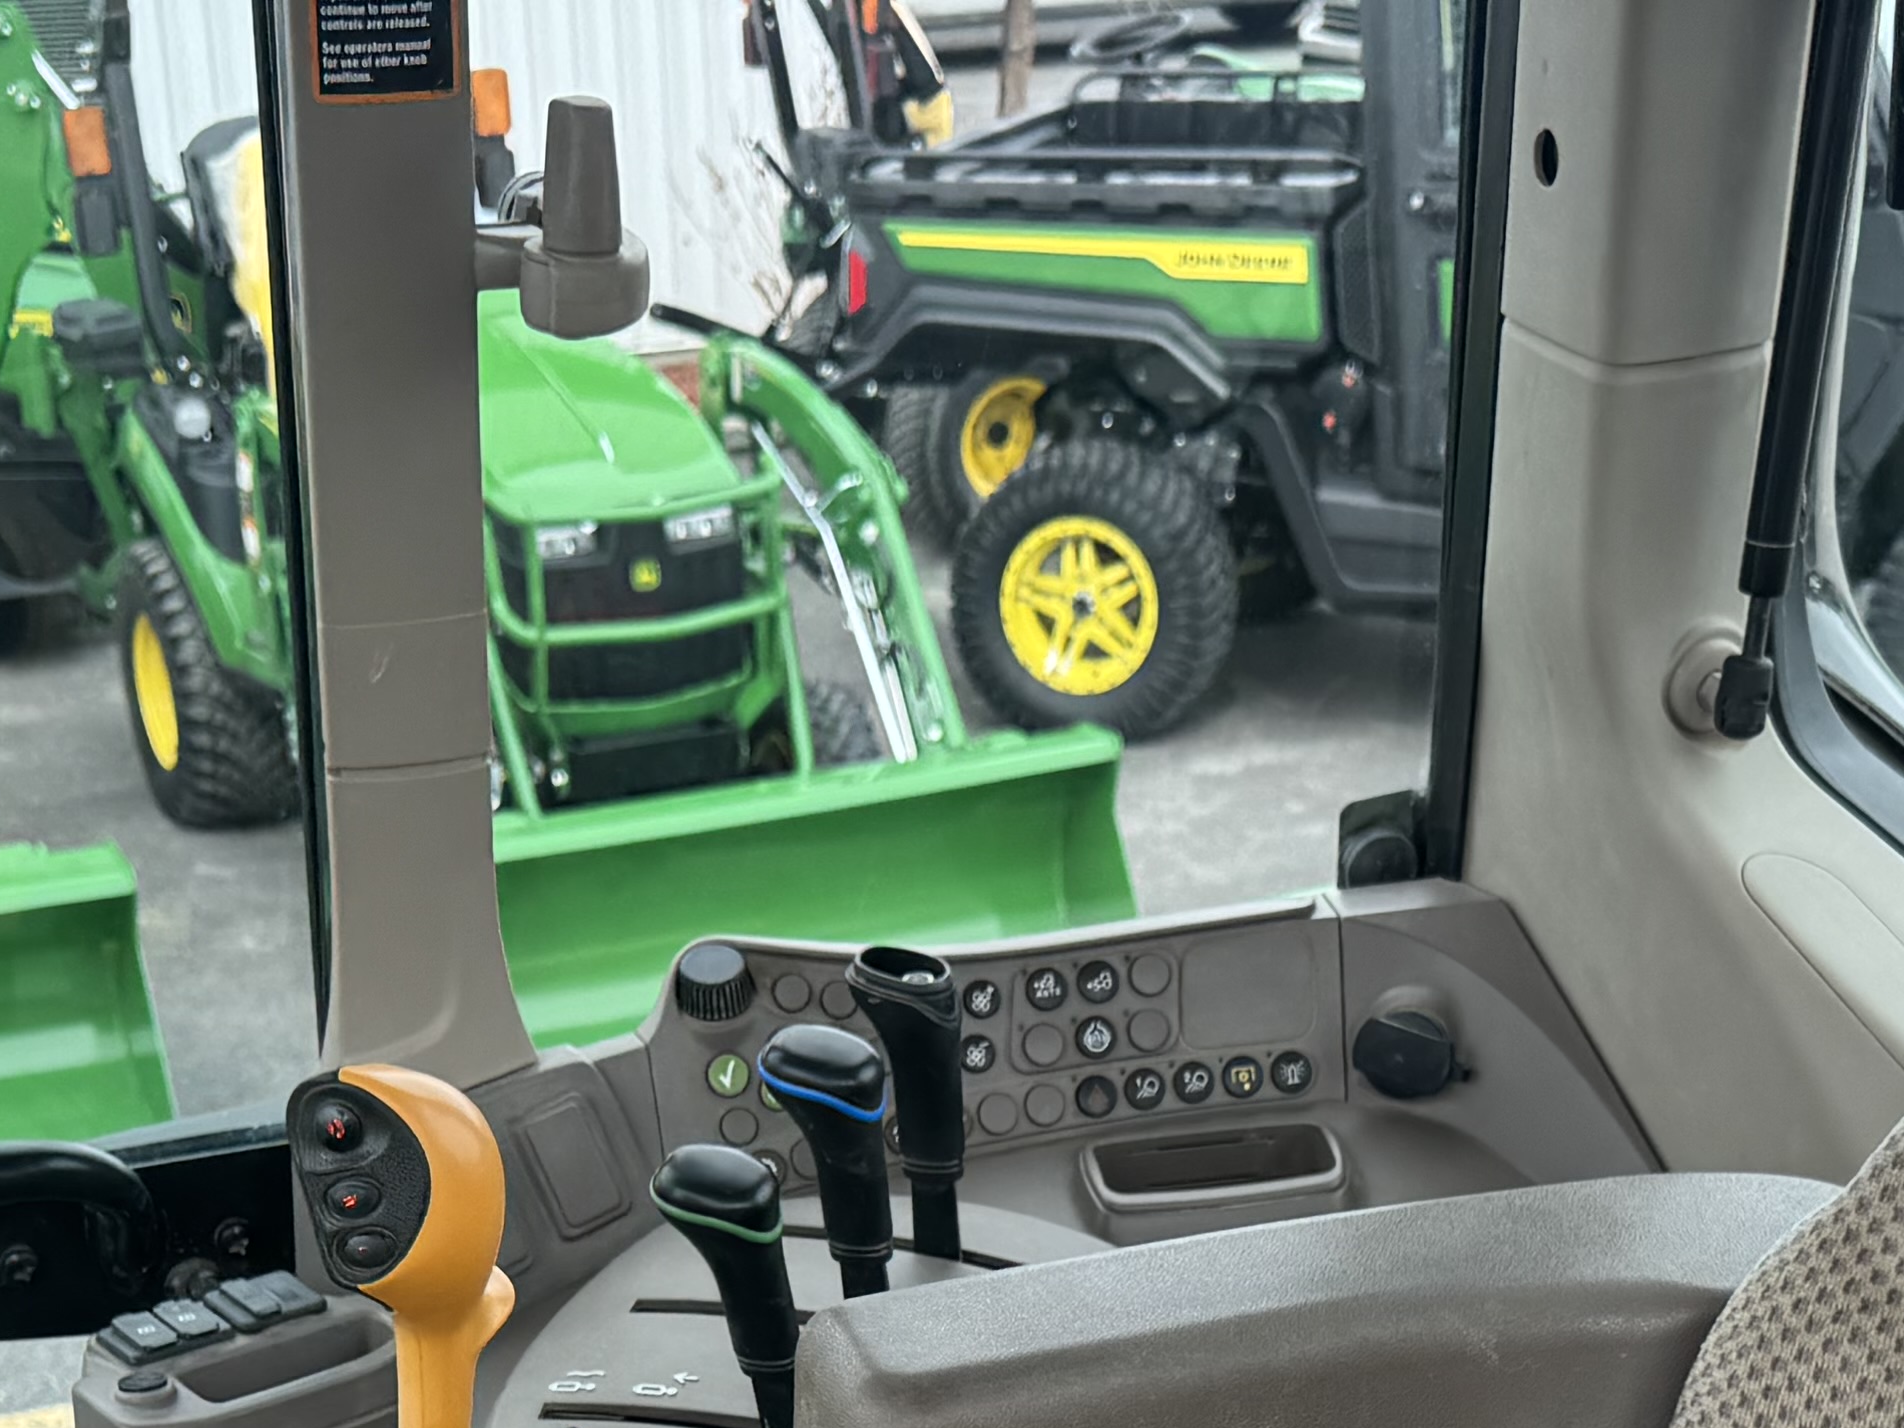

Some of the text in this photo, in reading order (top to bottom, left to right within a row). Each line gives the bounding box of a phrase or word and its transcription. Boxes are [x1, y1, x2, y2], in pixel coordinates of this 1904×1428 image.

[367, 3, 378, 15] to
[381, 3, 408, 14] move
[410, 1, 432, 13] after
[321, 14, 430, 31] controls are released.
[322, 41, 341, 55] See
[395, 38, 431, 52] manual
[322, 57, 337, 69] for
[340, 58, 358, 69] use
[361, 55, 372, 67] of
[323, 72, 374, 85] positions.
